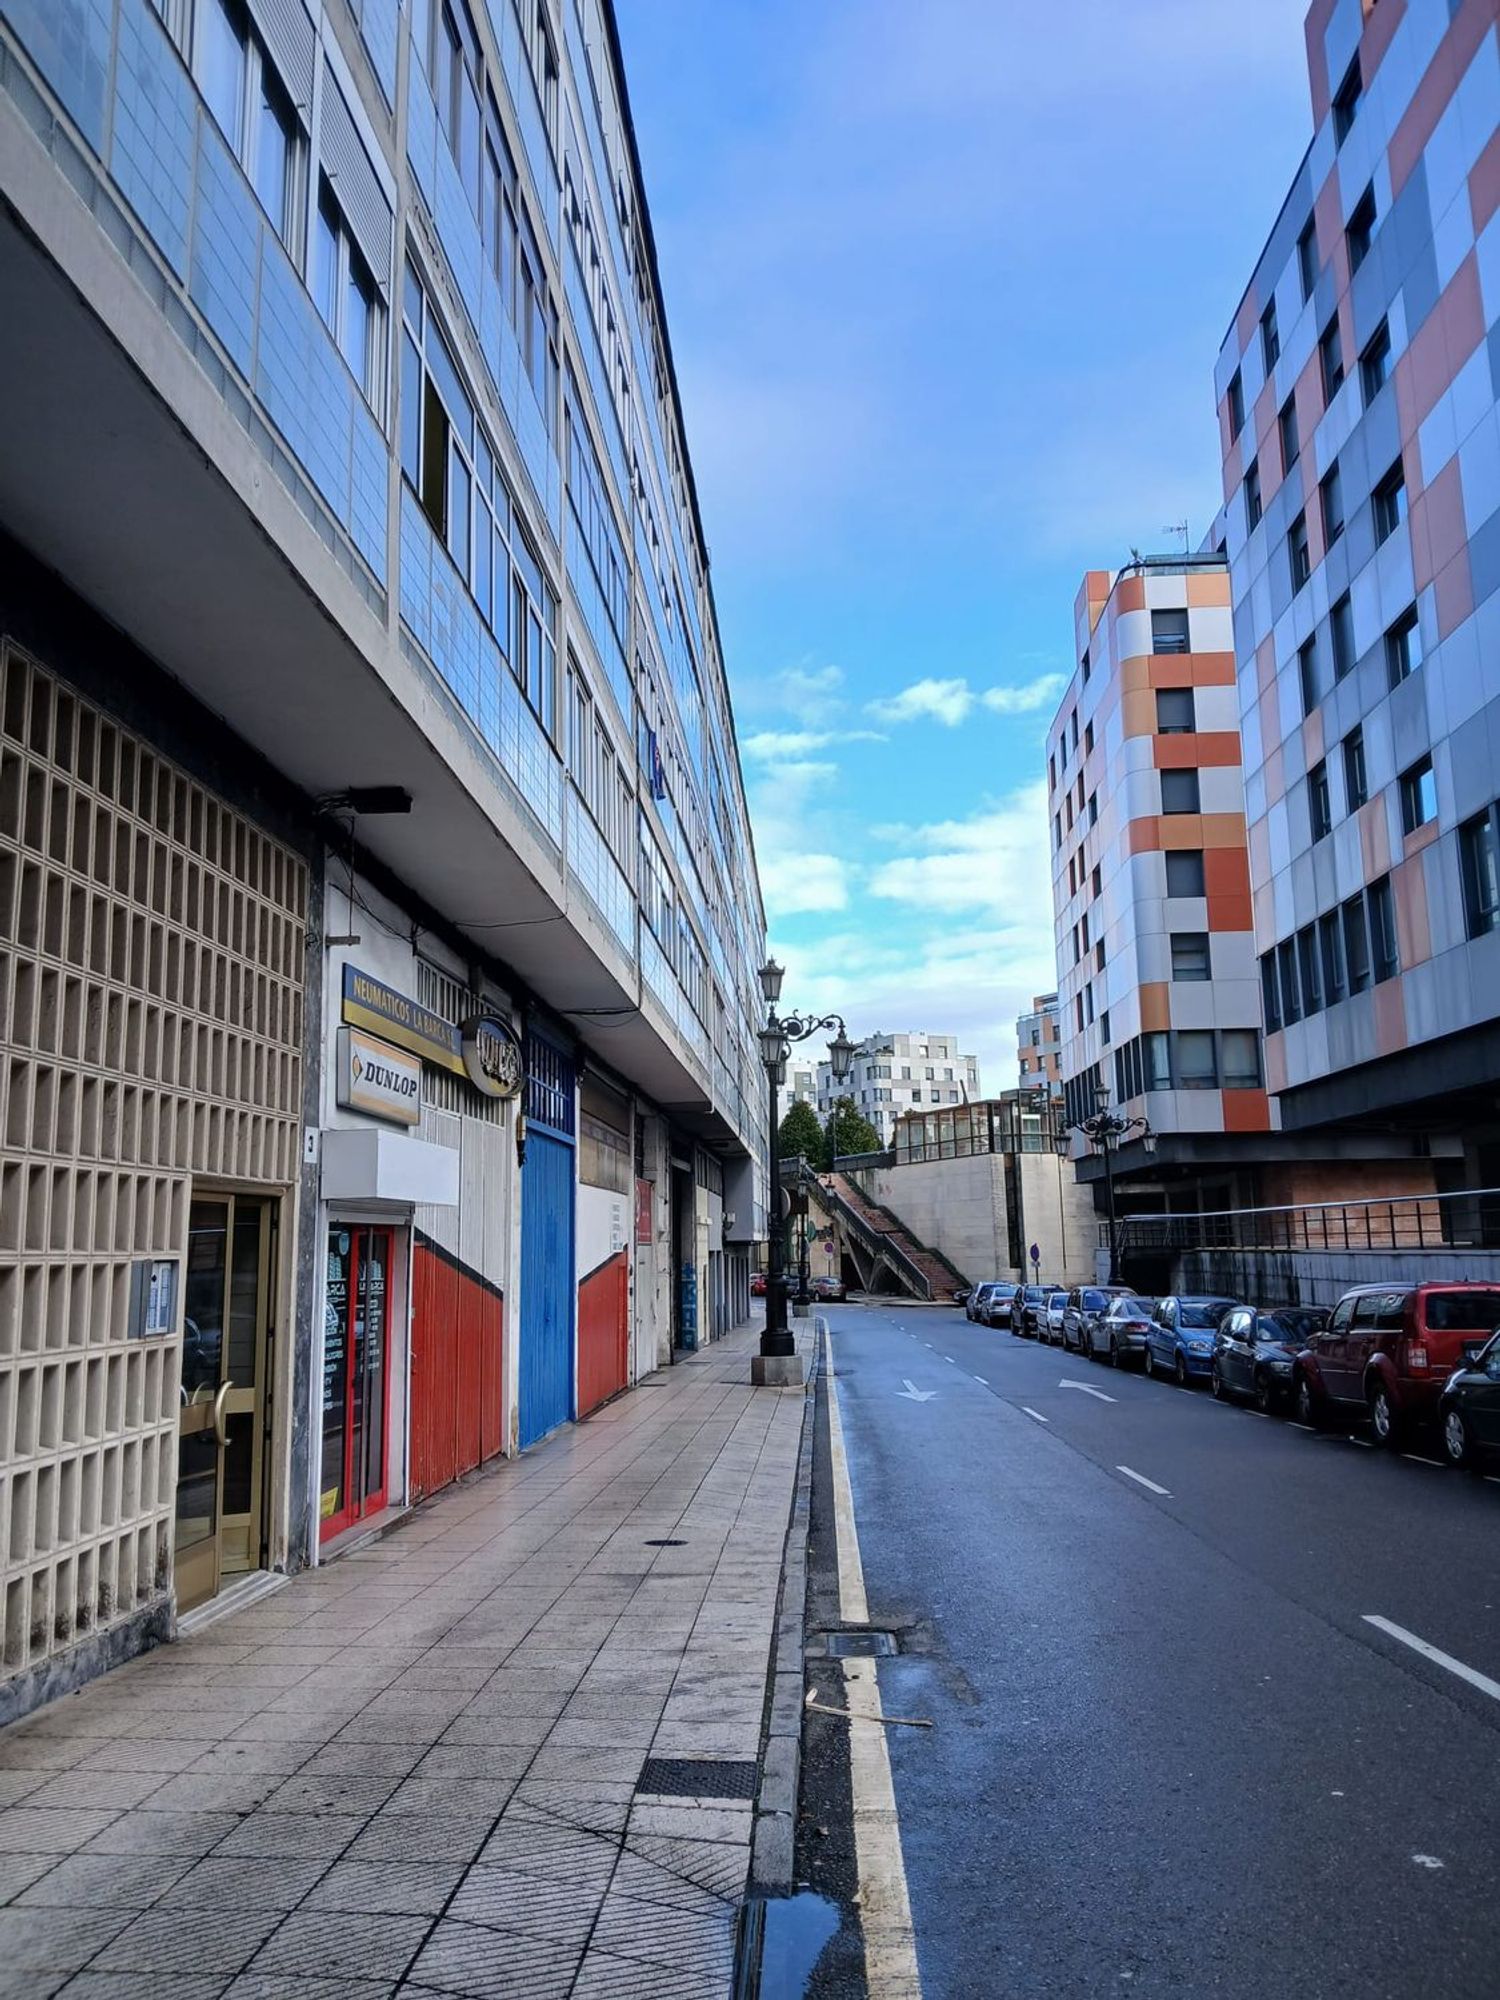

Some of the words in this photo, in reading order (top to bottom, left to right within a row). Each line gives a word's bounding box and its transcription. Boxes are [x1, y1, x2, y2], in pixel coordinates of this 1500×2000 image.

[353, 974, 410, 1024] NEUMATICOS
[364, 1061, 417, 1097] DUNLOP
[308, 1135, 314, 1152] 3
